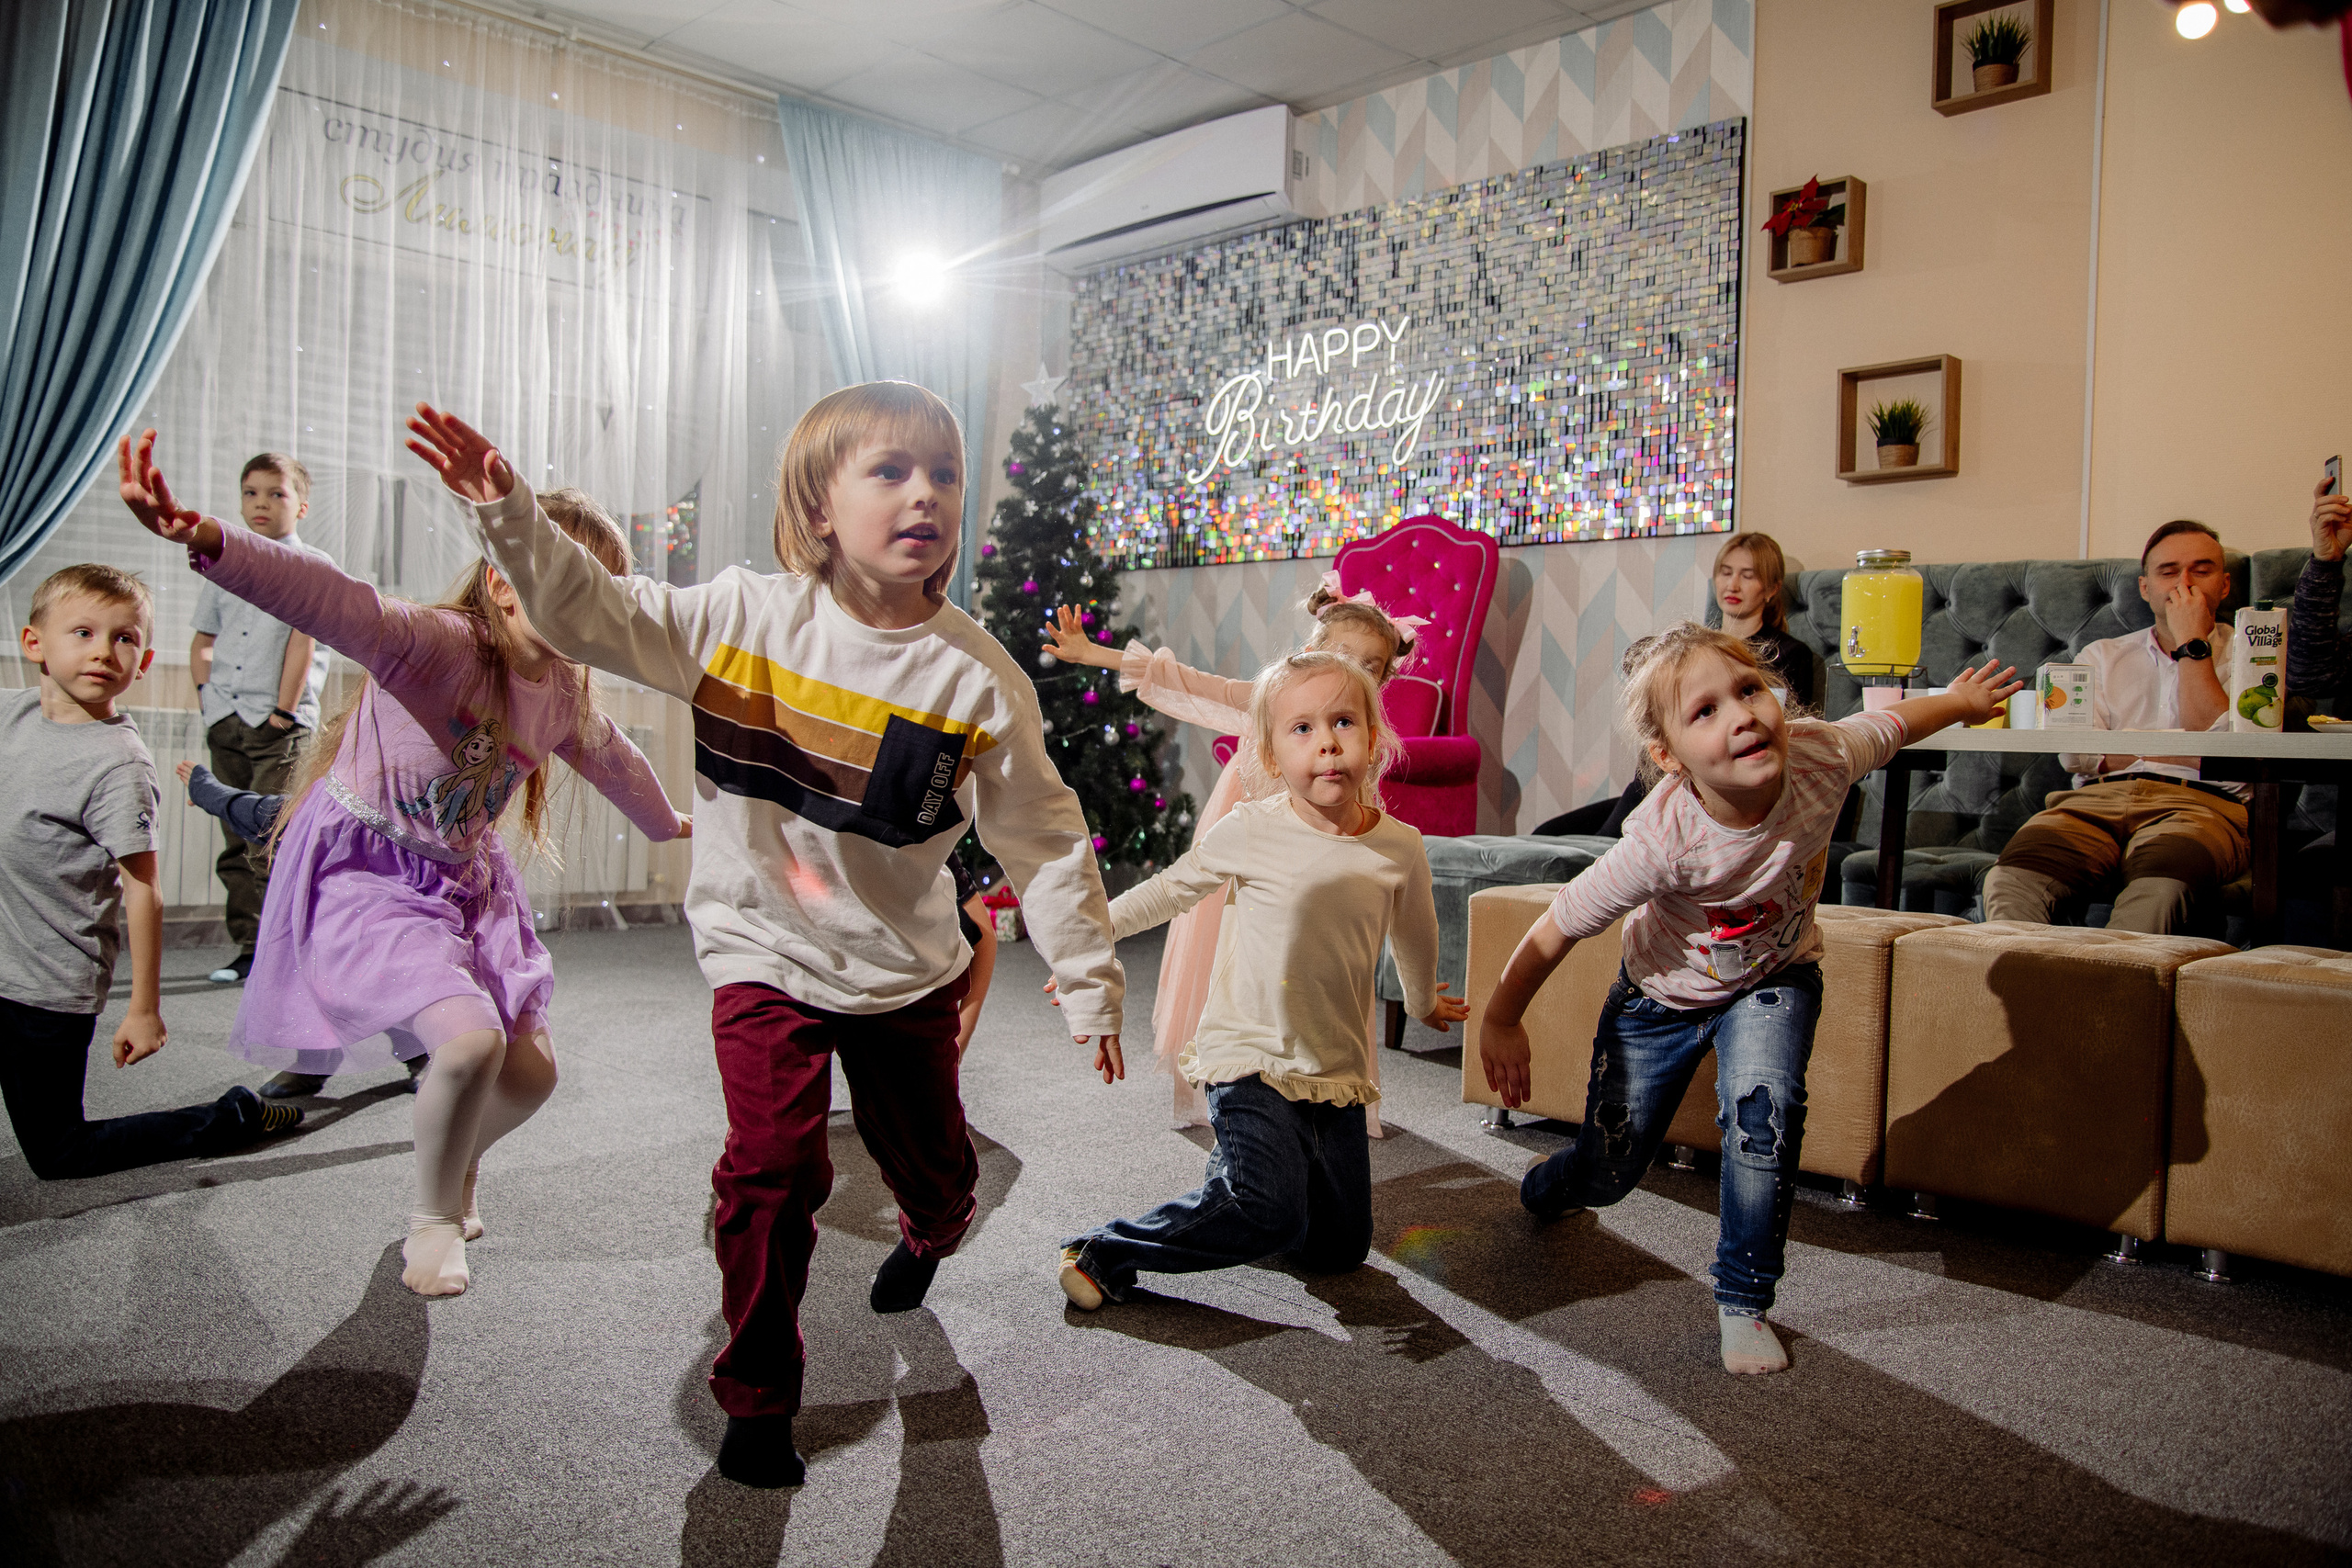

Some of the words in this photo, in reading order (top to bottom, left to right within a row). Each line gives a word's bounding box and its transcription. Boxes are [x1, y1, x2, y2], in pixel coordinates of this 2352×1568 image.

[495, 160, 686, 227] праздниа
[1267, 315, 1410, 380] HAPPY
[1186, 369, 1445, 485] Birthday
[2245, 624, 2282, 637] Global
[2247, 635, 2283, 648] Village
[917, 789, 944, 826] DAY
[931, 752, 955, 789] OFF
